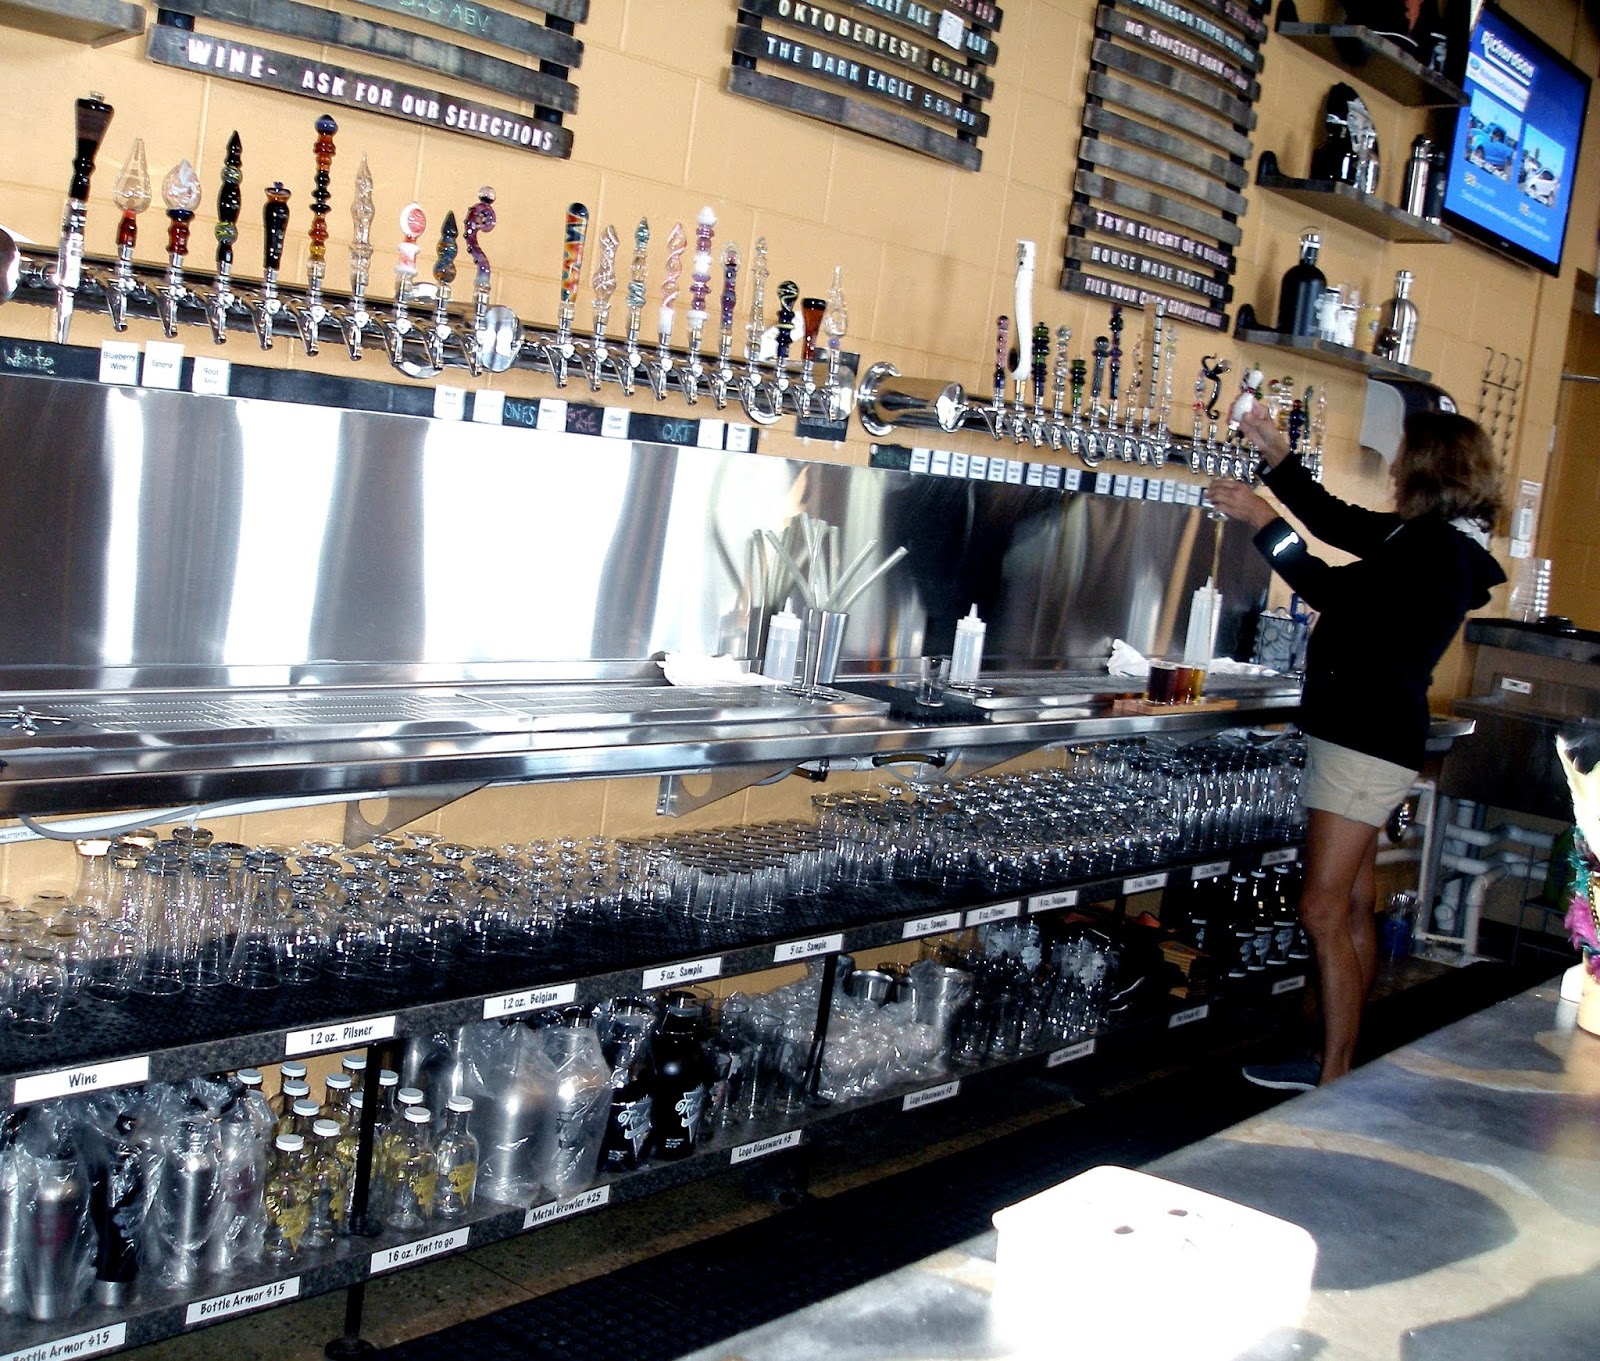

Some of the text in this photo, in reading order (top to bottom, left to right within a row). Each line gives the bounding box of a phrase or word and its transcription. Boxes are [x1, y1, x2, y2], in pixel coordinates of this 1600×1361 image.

[449, 3, 489, 32] ABV
[907, 3, 931, 26] ALE
[778, 0, 920, 63] OKTOBERFEST
[1149, 29, 1198, 63] SINISTER
[767, 36, 802, 64] THE
[812, 51, 860, 82] DARK
[867, 69, 914, 102] EAGLE
[188, 38, 554, 151] WINE- ASK FOR OUR SELECTIONS
[1096, 212, 1124, 232] TRY
[1125, 222, 1135, 236] A
[1138, 225, 1181, 250] FLIGHT
[1091, 246, 1136, 270] HOUSE
[1140, 259, 1173, 281] MADE
[1110, 283, 1138, 303] YOUR
[103, 351, 136, 363] Blueberry
[110, 363, 128, 371] Wine
[790, 944, 796, 955] 5
[807, 939, 827, 952] Sample
[660, 963, 703, 981] 5 oz. Sample
[503, 991, 558, 1010] 12 oz. Belgian
[310, 1025, 373, 1045] 12 oz. Pilsner
[69, 1072, 97, 1088] Wine
[738, 1133, 792, 1157] Logo Glassware $5
[532, 1190, 602, 1222] Metal Growler $25
[388, 1237, 454, 1263] 16 oz. Pint to go
[201, 1282, 286, 1315] Bottle Armor $15
[50, 1339, 86, 1358] Armor
[88, 1331, 110, 1348] $15
